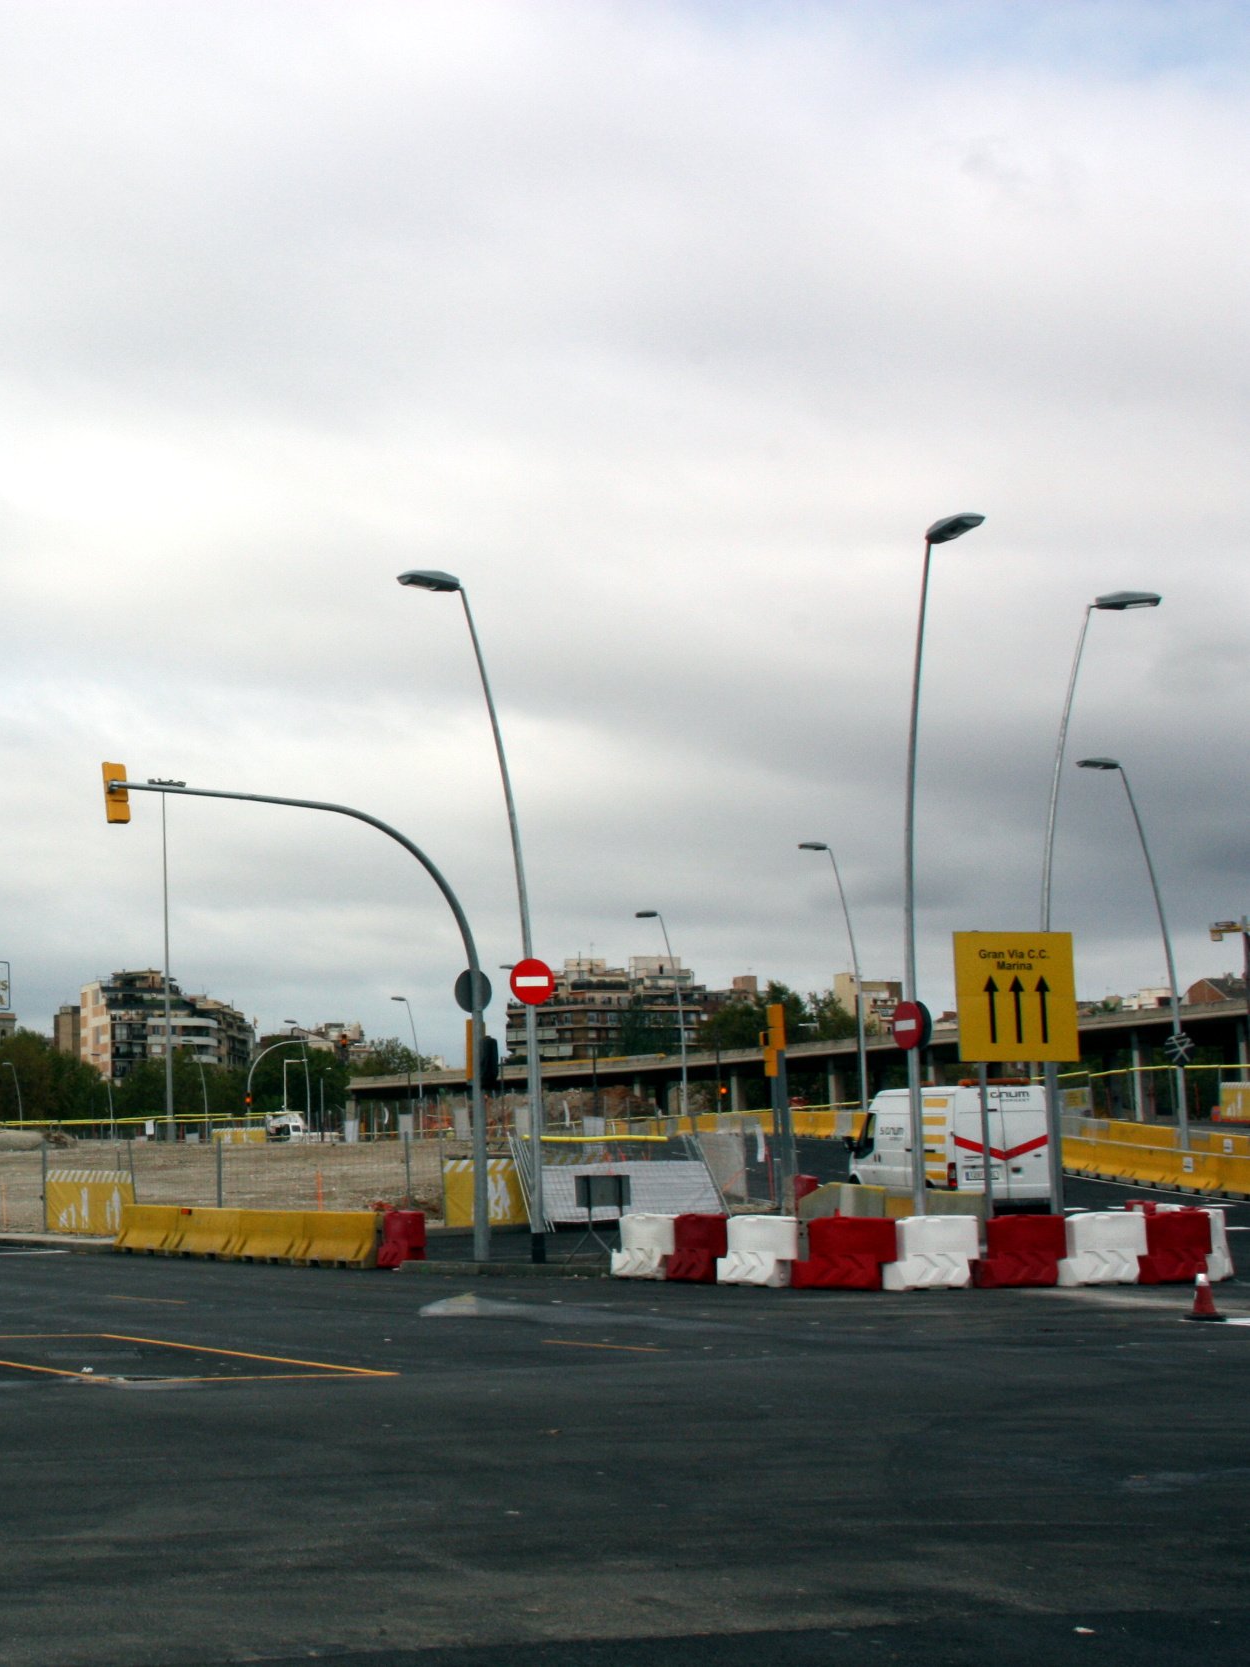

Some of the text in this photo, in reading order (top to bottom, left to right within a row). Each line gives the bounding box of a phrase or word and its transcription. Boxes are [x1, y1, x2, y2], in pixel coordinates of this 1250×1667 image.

[978, 949, 1049, 959] Gran Via C.C.
[996, 961, 1033, 970] Marina
